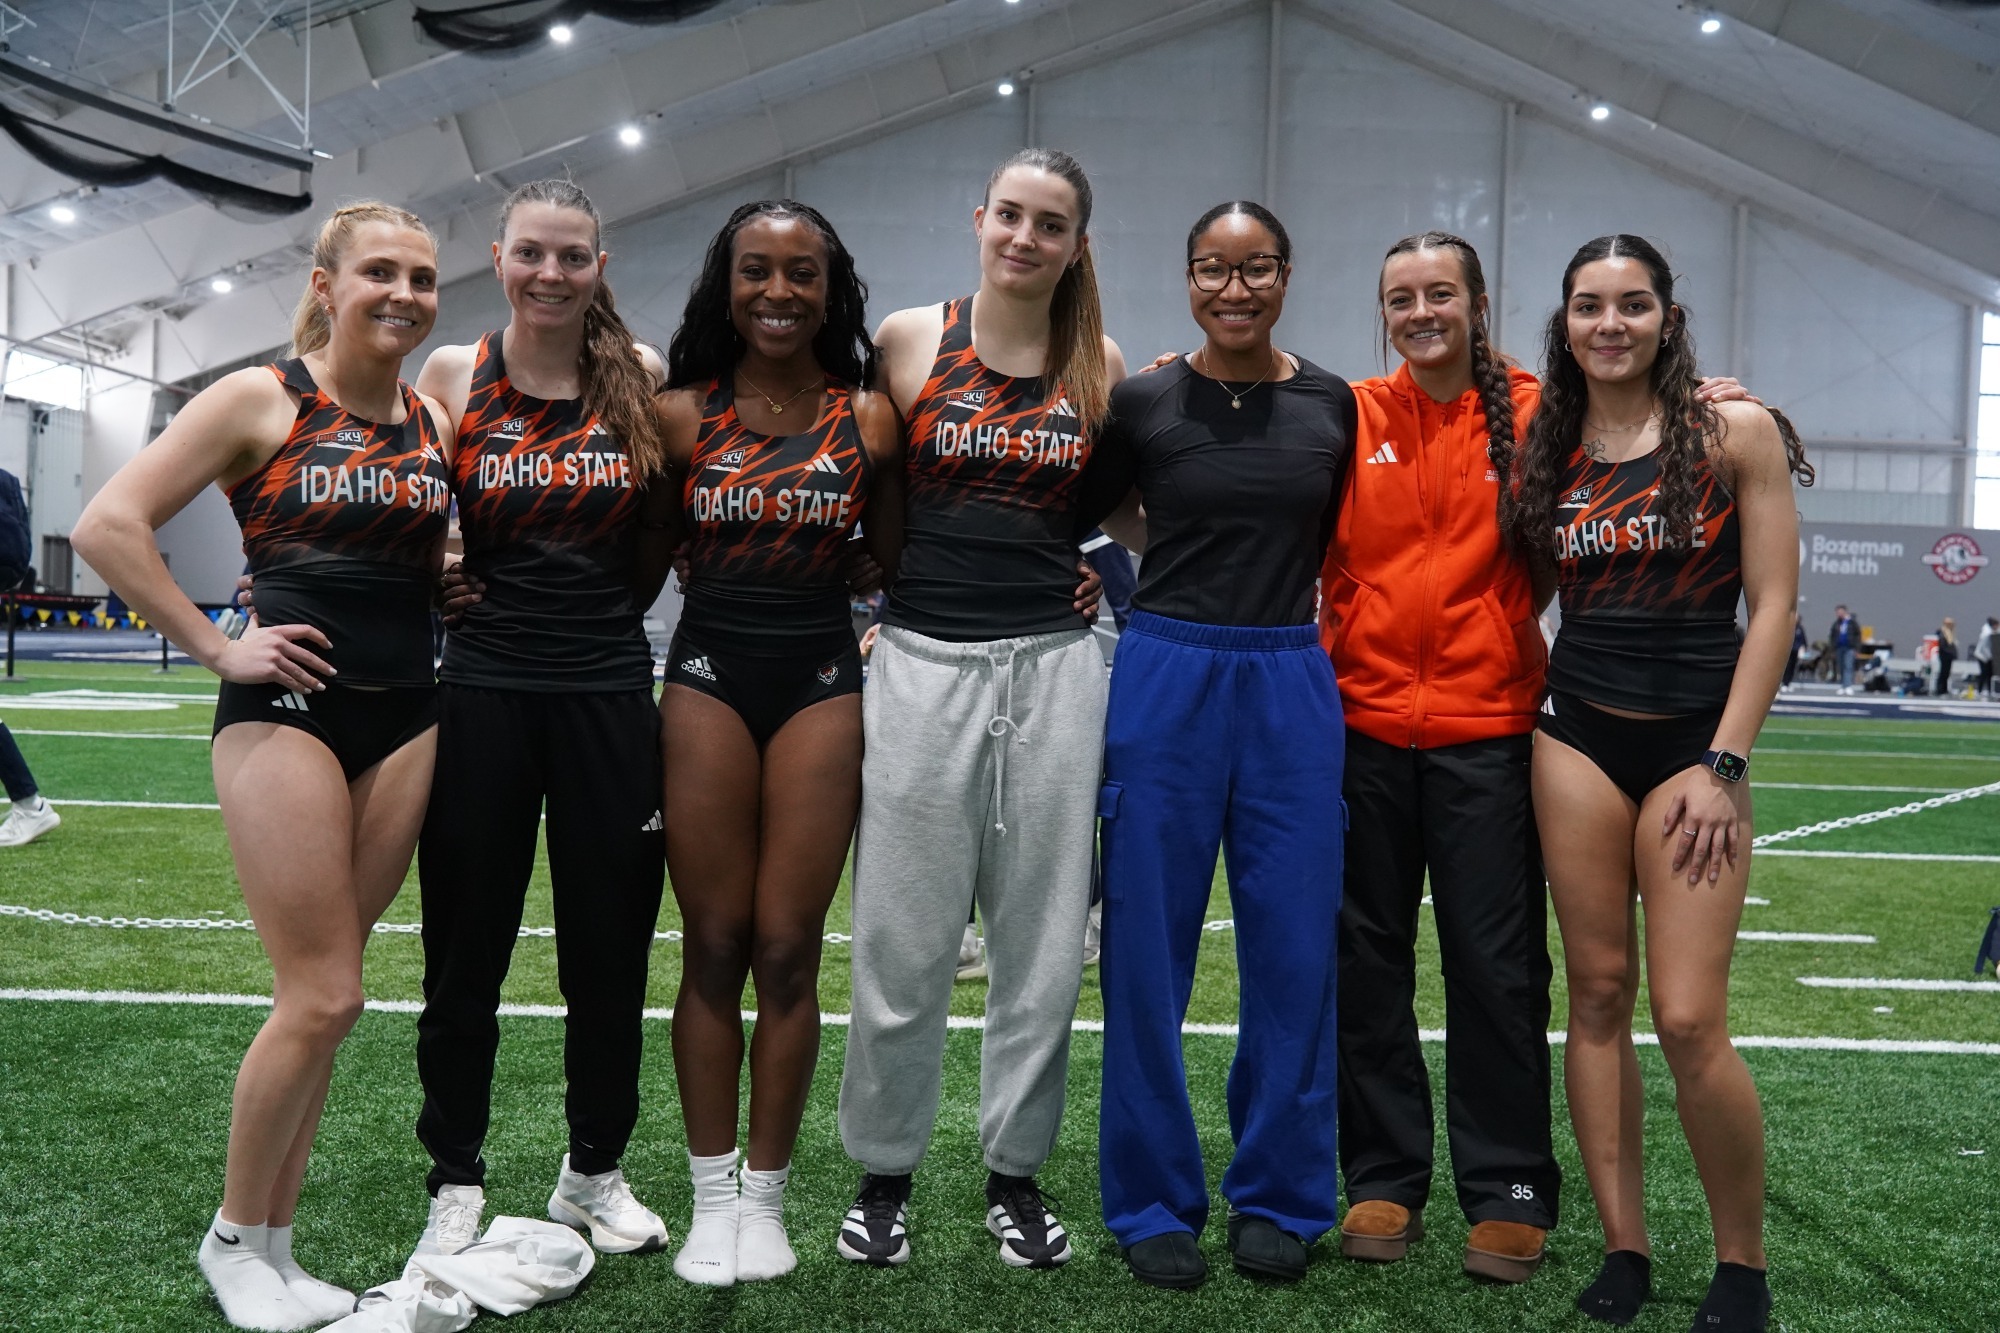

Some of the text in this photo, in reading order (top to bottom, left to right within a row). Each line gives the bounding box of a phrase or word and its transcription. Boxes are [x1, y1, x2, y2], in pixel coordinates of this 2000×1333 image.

[935, 421, 1083, 471] IDAHO STATE
[478, 452, 632, 490] IDAHO STATE
[301, 464, 449, 520] IDAHO STAT
[693, 486, 851, 528] IDAHO STATE
[1812, 534, 1904, 558] Bozeman
[1811, 554, 1879, 576] Health
[681, 662, 717, 681] adidas
[1511, 1183, 1534, 1200] 35
